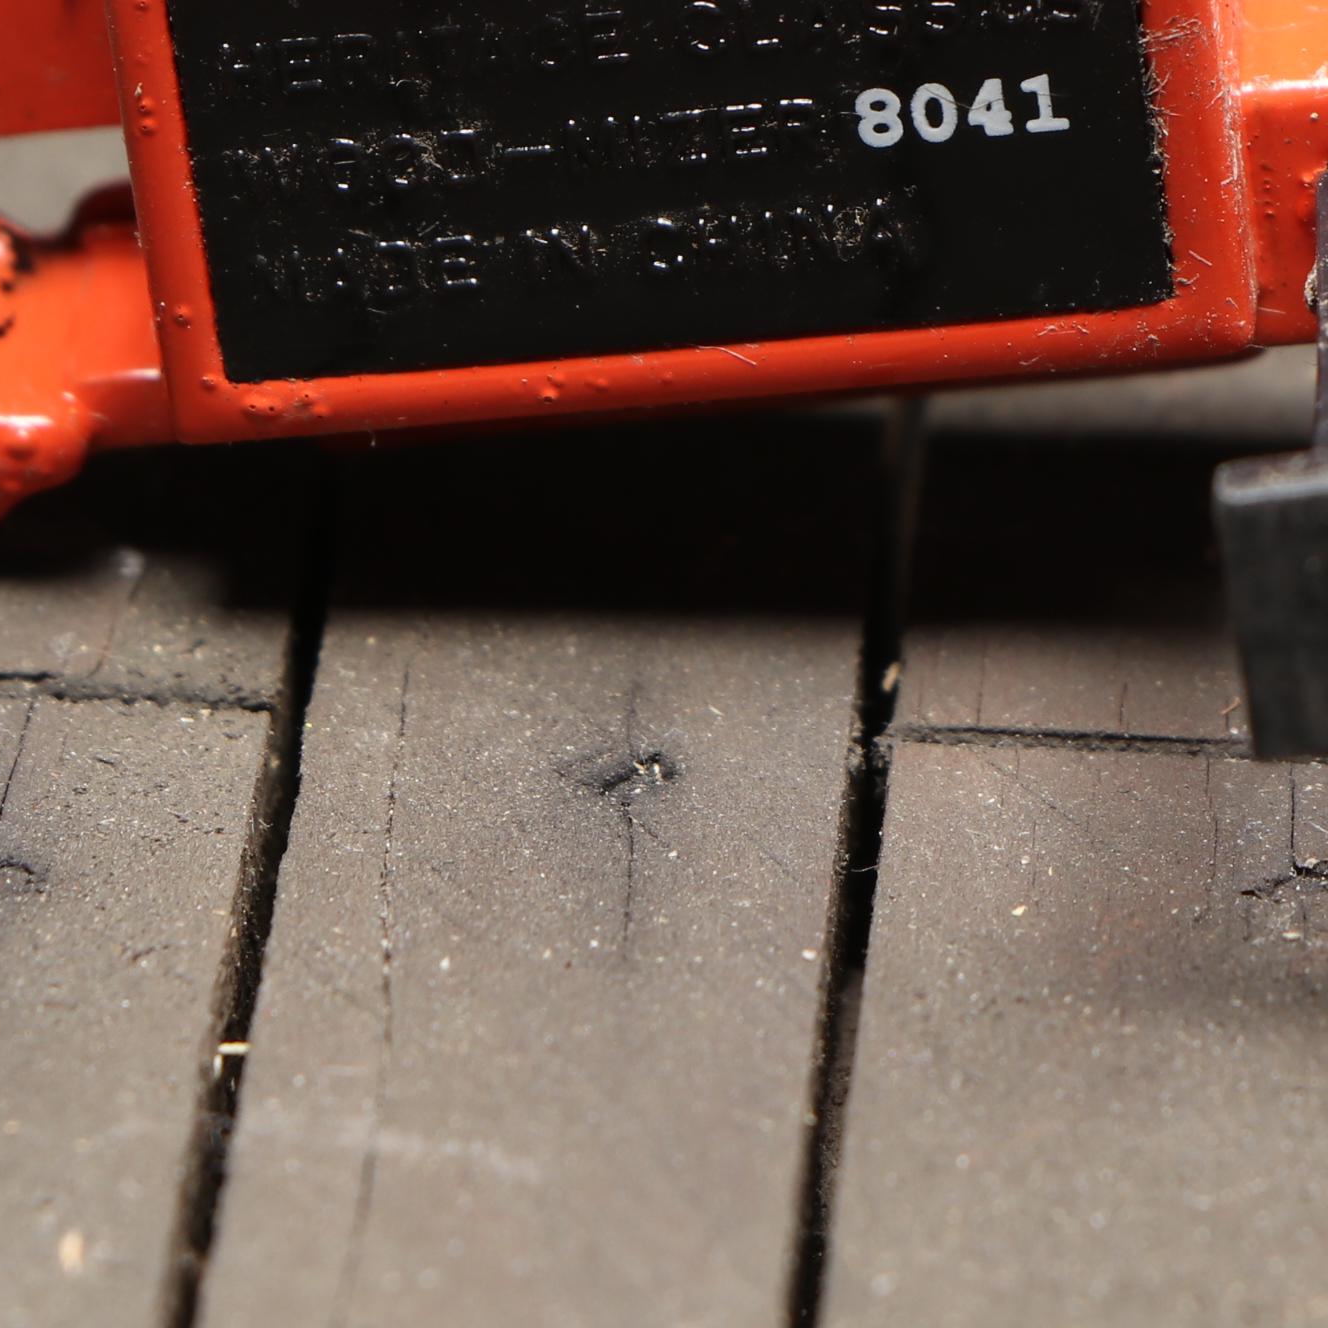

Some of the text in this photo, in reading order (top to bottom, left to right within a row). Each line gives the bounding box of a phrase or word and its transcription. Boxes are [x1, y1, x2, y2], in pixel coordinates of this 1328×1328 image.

[855, 74, 1070, 148] 8041
[249, 195, 910, 305] MADE IN CHINA
